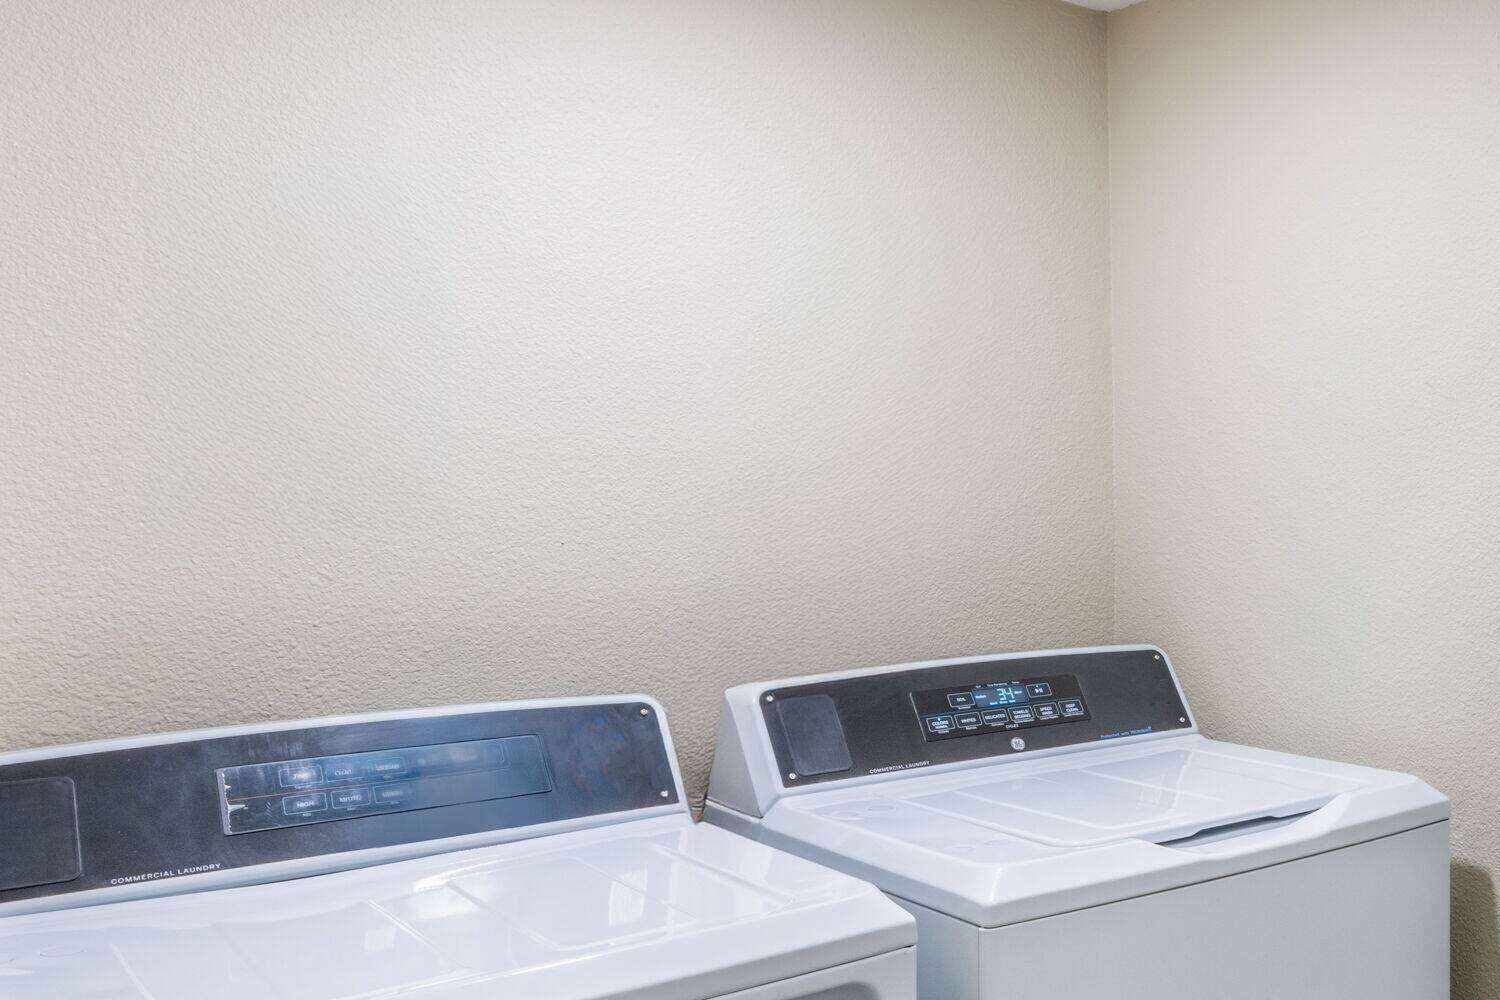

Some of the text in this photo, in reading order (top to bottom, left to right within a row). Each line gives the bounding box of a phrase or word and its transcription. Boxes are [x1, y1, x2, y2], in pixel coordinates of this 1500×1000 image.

[996, 687, 1015, 701] 34
[869, 760, 930, 774] COMMERCIAL LAUNDRY
[110, 863, 222, 885] COMMERCIAL LAUNDRY
